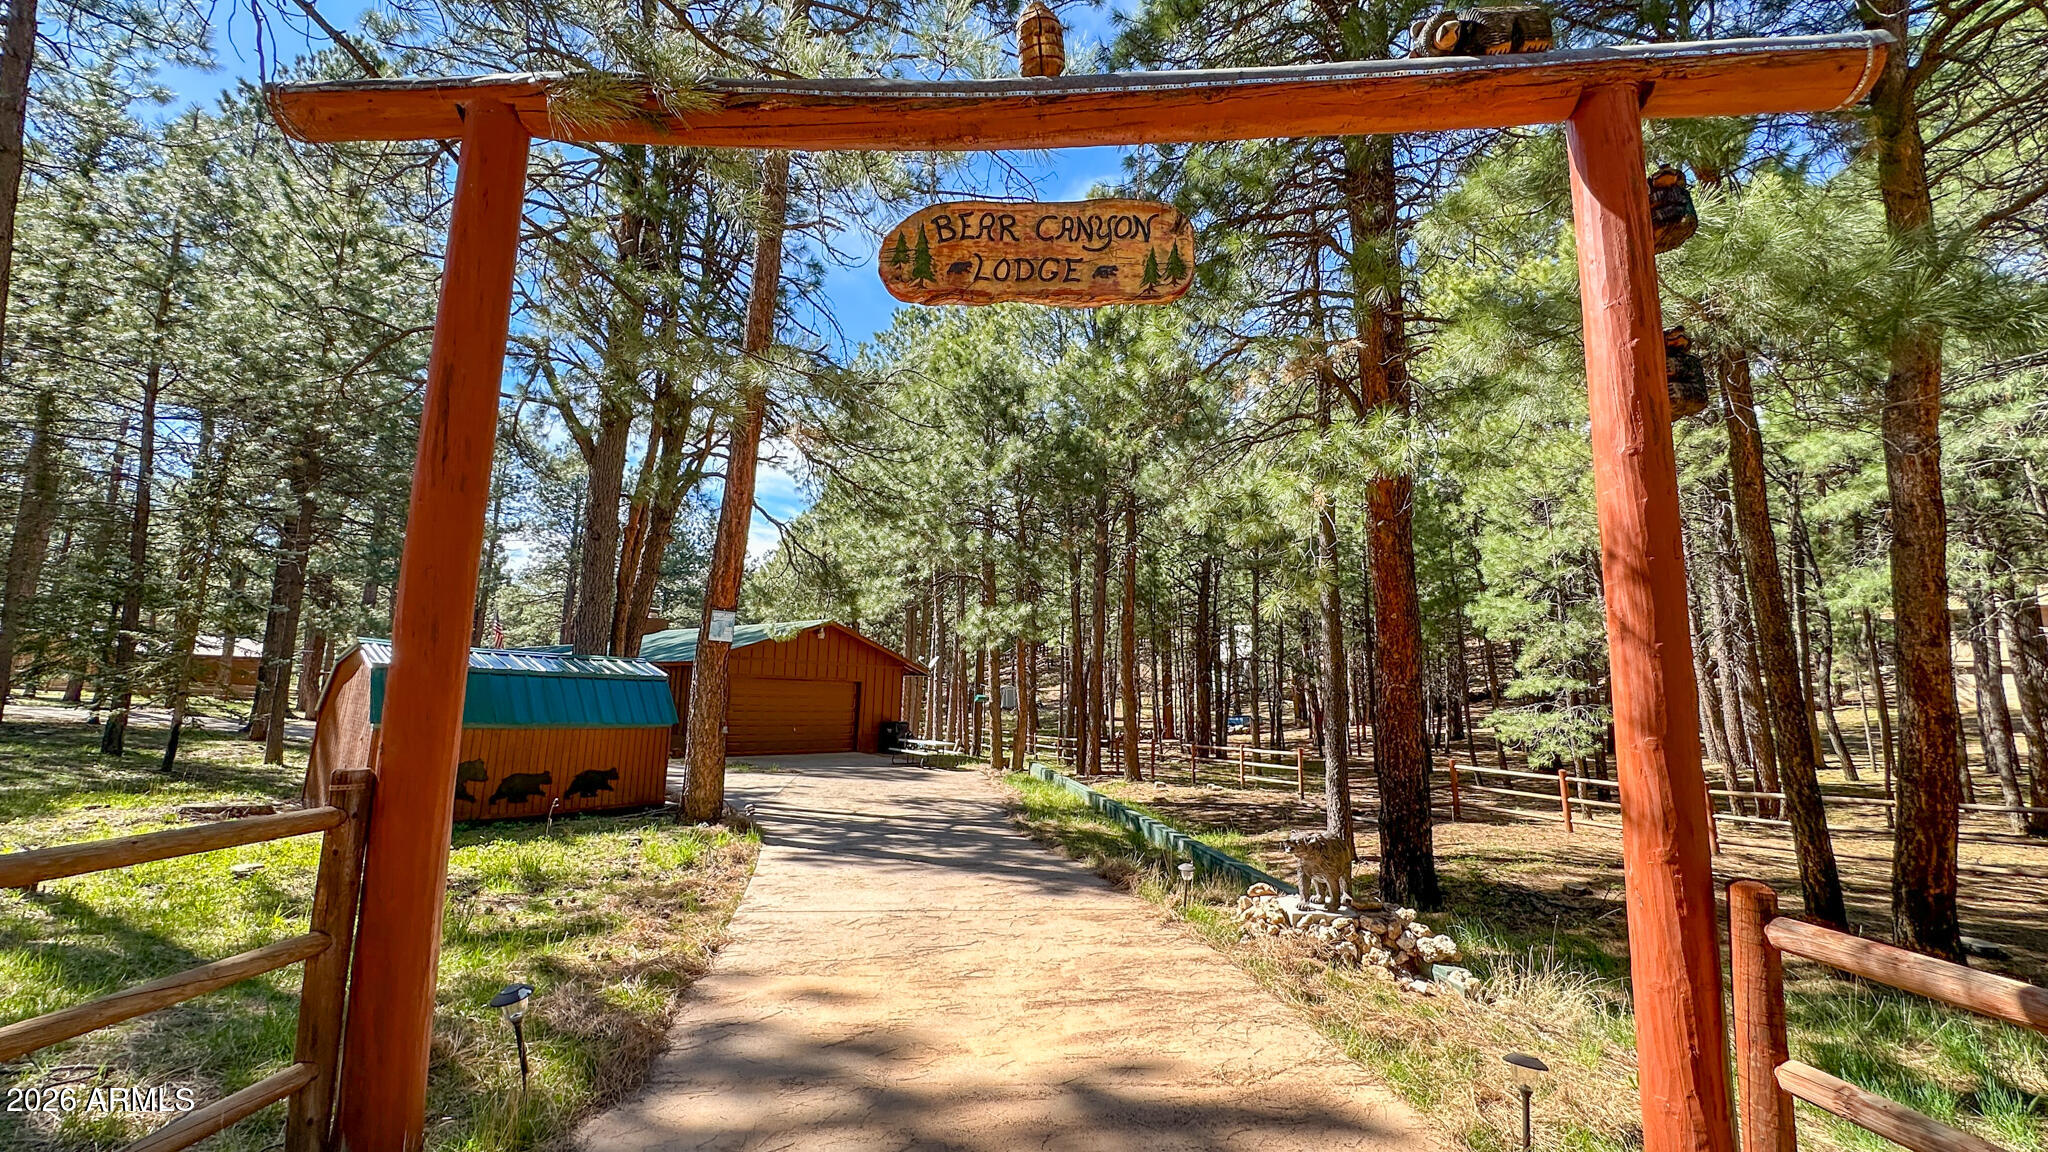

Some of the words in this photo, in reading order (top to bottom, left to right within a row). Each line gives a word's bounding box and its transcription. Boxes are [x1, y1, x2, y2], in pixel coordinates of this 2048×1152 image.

[931, 211, 1020, 243] BEAR
[1035, 213, 1159, 252] CANYON
[973, 253, 1084, 283] LODGE
